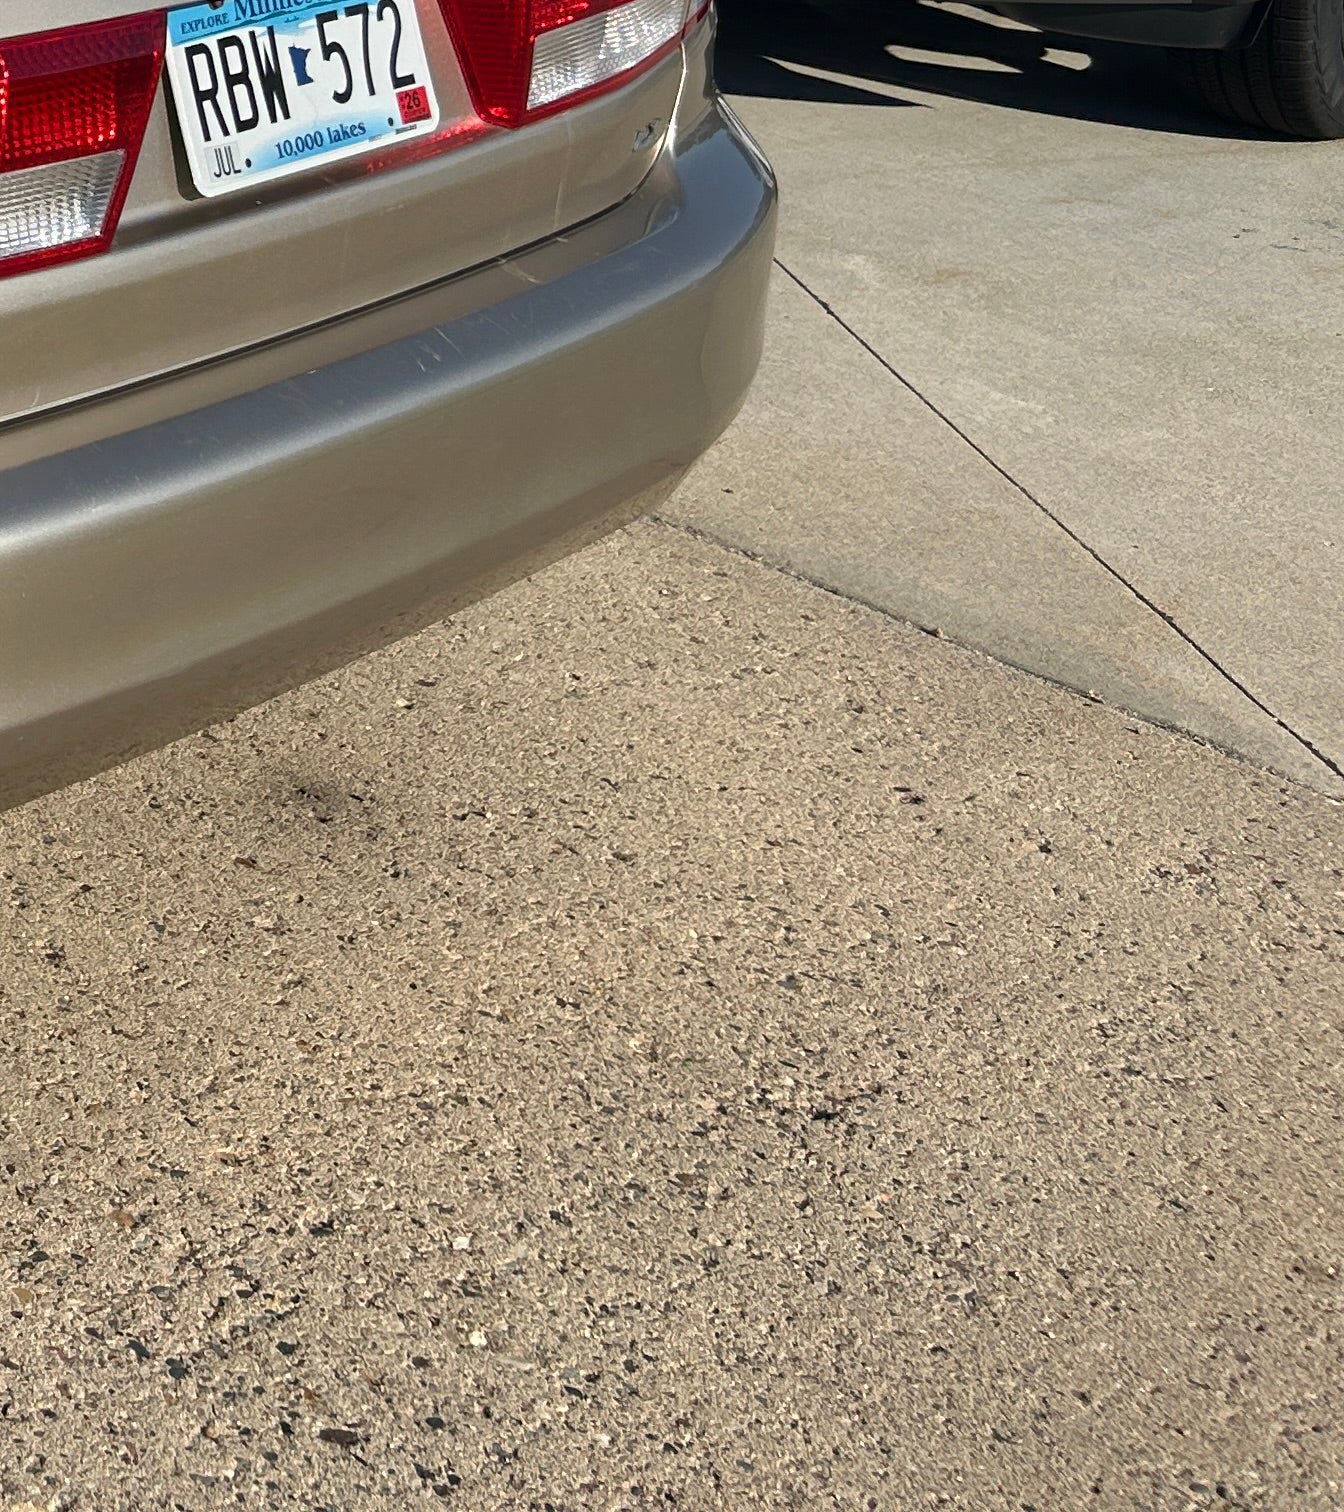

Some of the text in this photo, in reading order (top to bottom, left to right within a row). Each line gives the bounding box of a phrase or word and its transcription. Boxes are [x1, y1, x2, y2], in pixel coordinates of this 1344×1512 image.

[180, 13, 230, 35] EXPLORE
[184, 25, 292, 143] RBW
[404, 90, 421, 110] 26
[275, 133, 324, 160] 10,000
[326, 120, 367, 146] lakes
[212, 146, 242, 178] JUL
